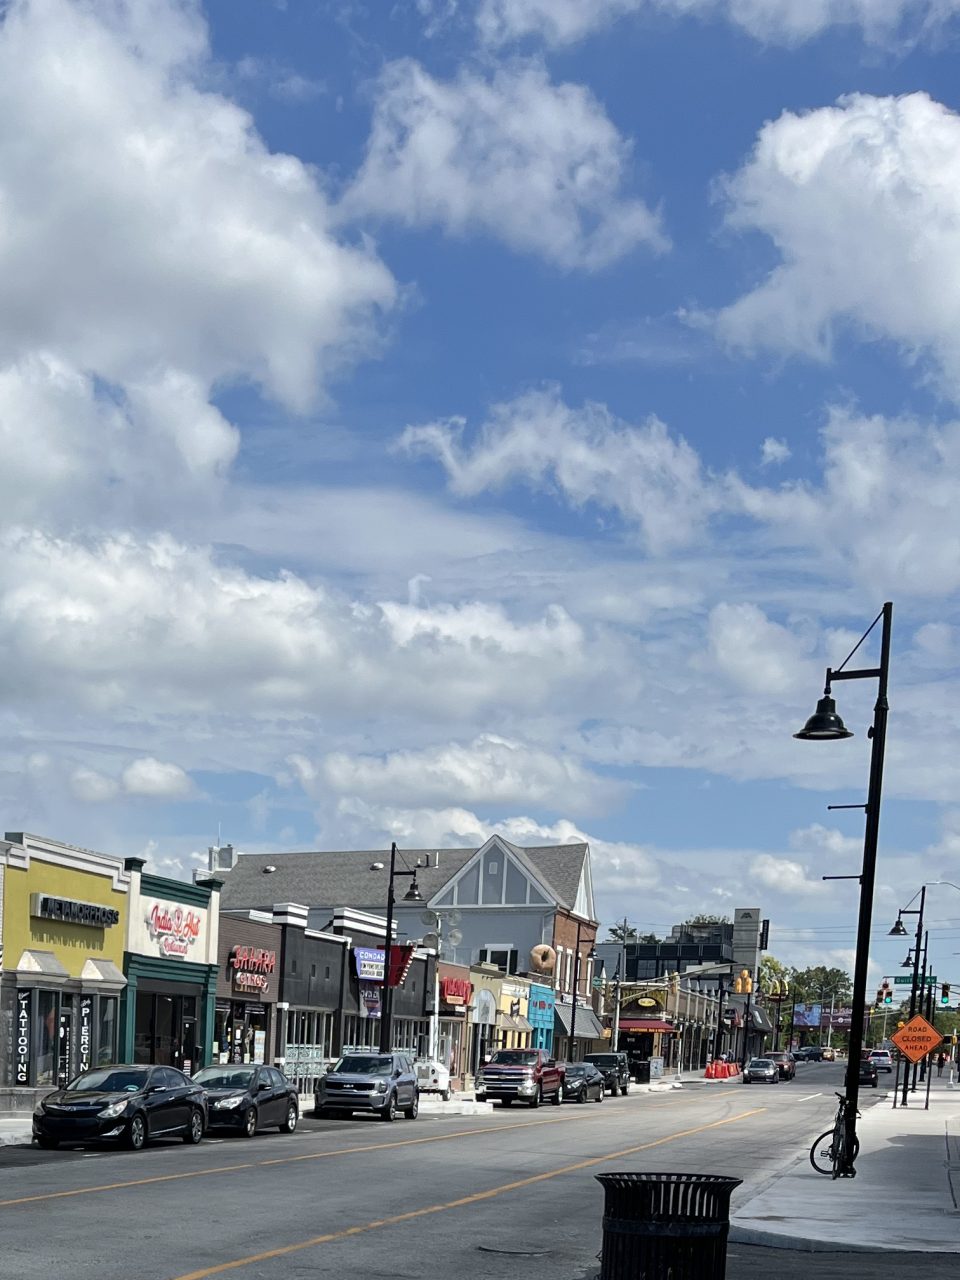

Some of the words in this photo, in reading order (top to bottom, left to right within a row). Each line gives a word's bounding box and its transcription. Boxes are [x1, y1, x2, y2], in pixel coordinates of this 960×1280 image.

[47, 898, 119, 925] METAMORPHOSIS
[359, 951, 386, 961] CONDAD
[17, 1000, 28, 1082] TATTOOING
[80, 1007, 90, 1072] PIERCIN
